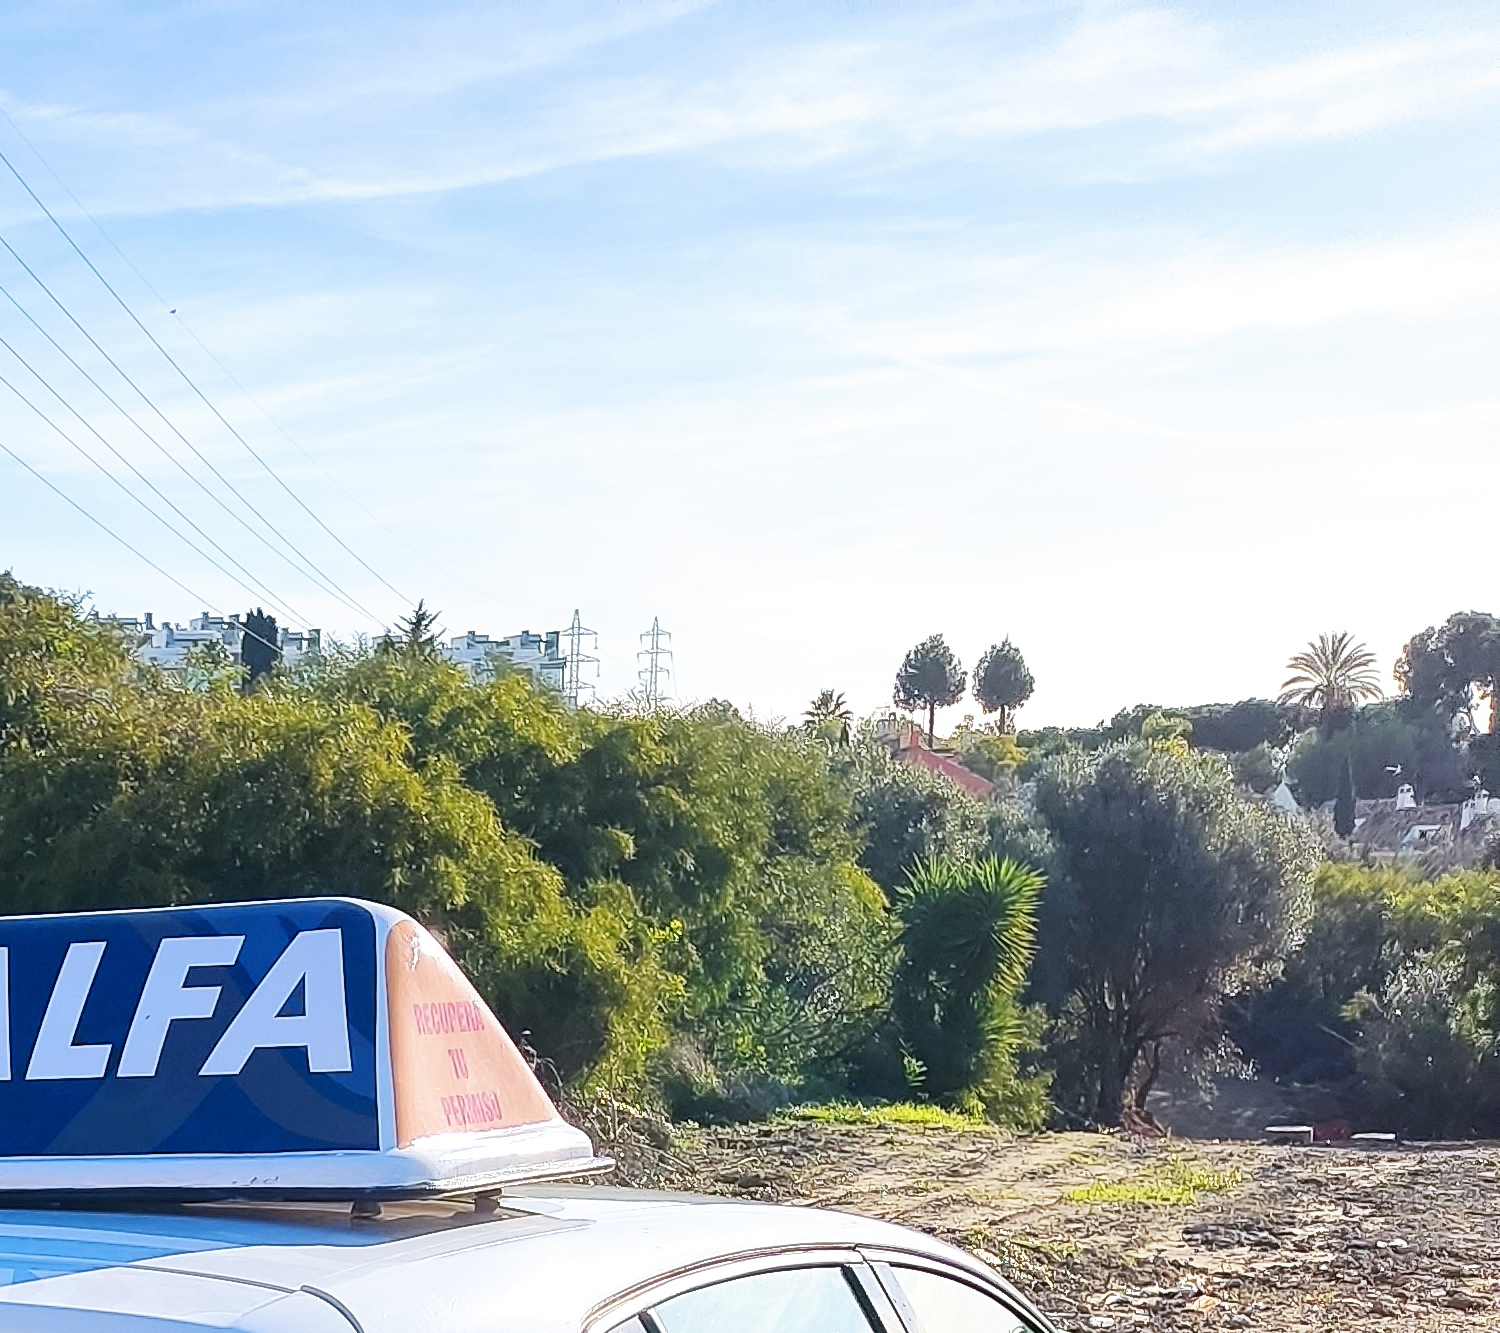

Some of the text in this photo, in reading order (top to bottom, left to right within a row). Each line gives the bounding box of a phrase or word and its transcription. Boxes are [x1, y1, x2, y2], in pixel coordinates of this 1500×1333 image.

[413, 1000, 485, 1035] RECUPERA
[447, 1049, 469, 1079] TU
[440, 1091, 503, 1127] PERMISO
